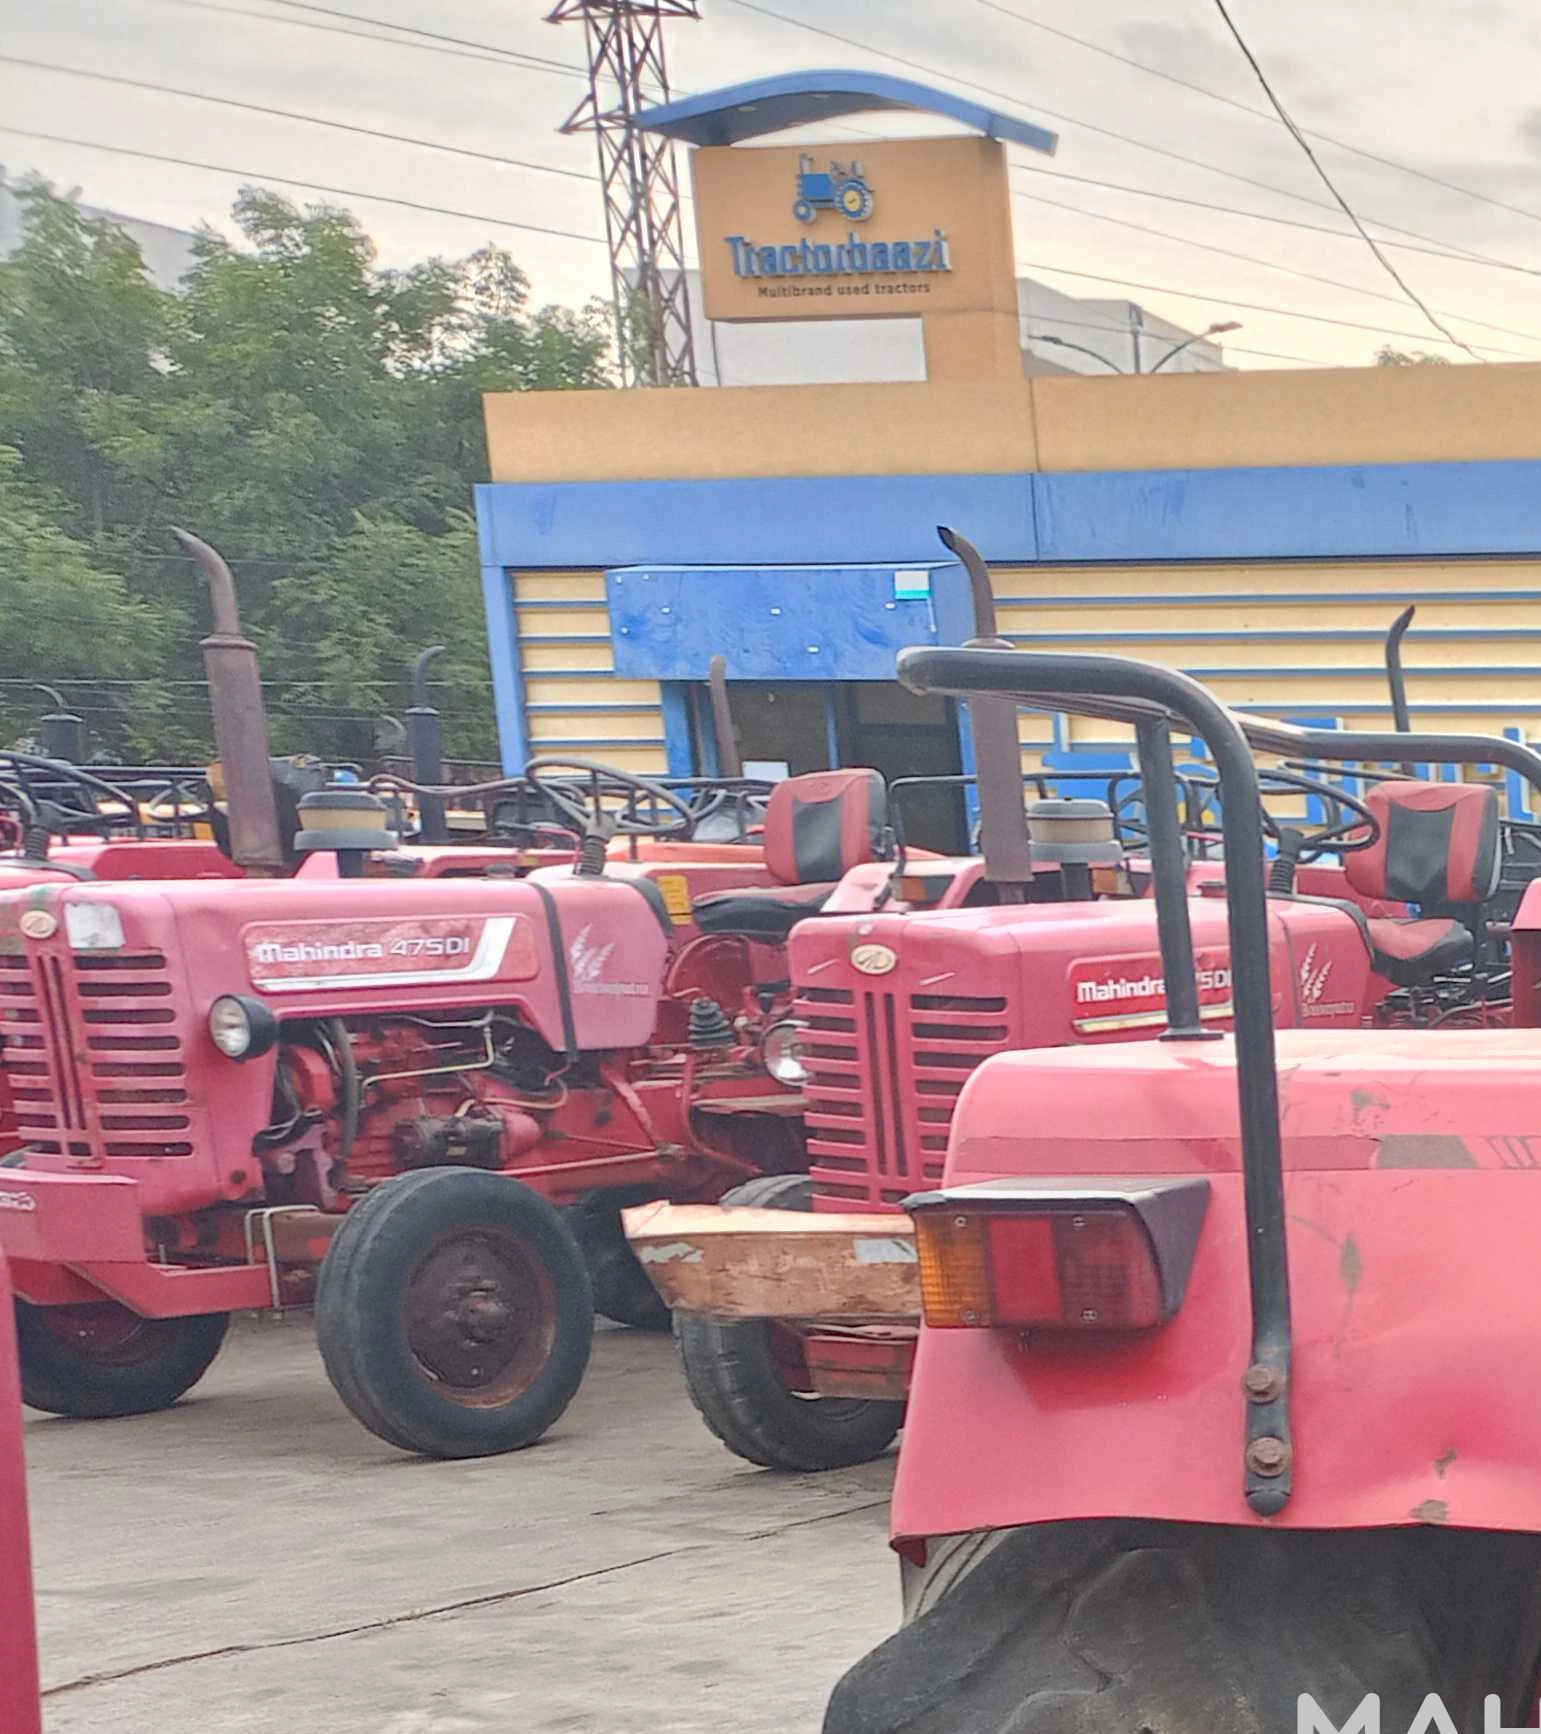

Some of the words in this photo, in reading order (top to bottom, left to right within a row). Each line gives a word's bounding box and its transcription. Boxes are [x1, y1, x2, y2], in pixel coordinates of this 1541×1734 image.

[724, 229, 952, 279] Tractorbaazi
[758, 285, 832, 298] Multibrand
[837, 283, 870, 296] used
[874, 281, 931, 295] tractors
[255, 940, 382, 964] Mahindra
